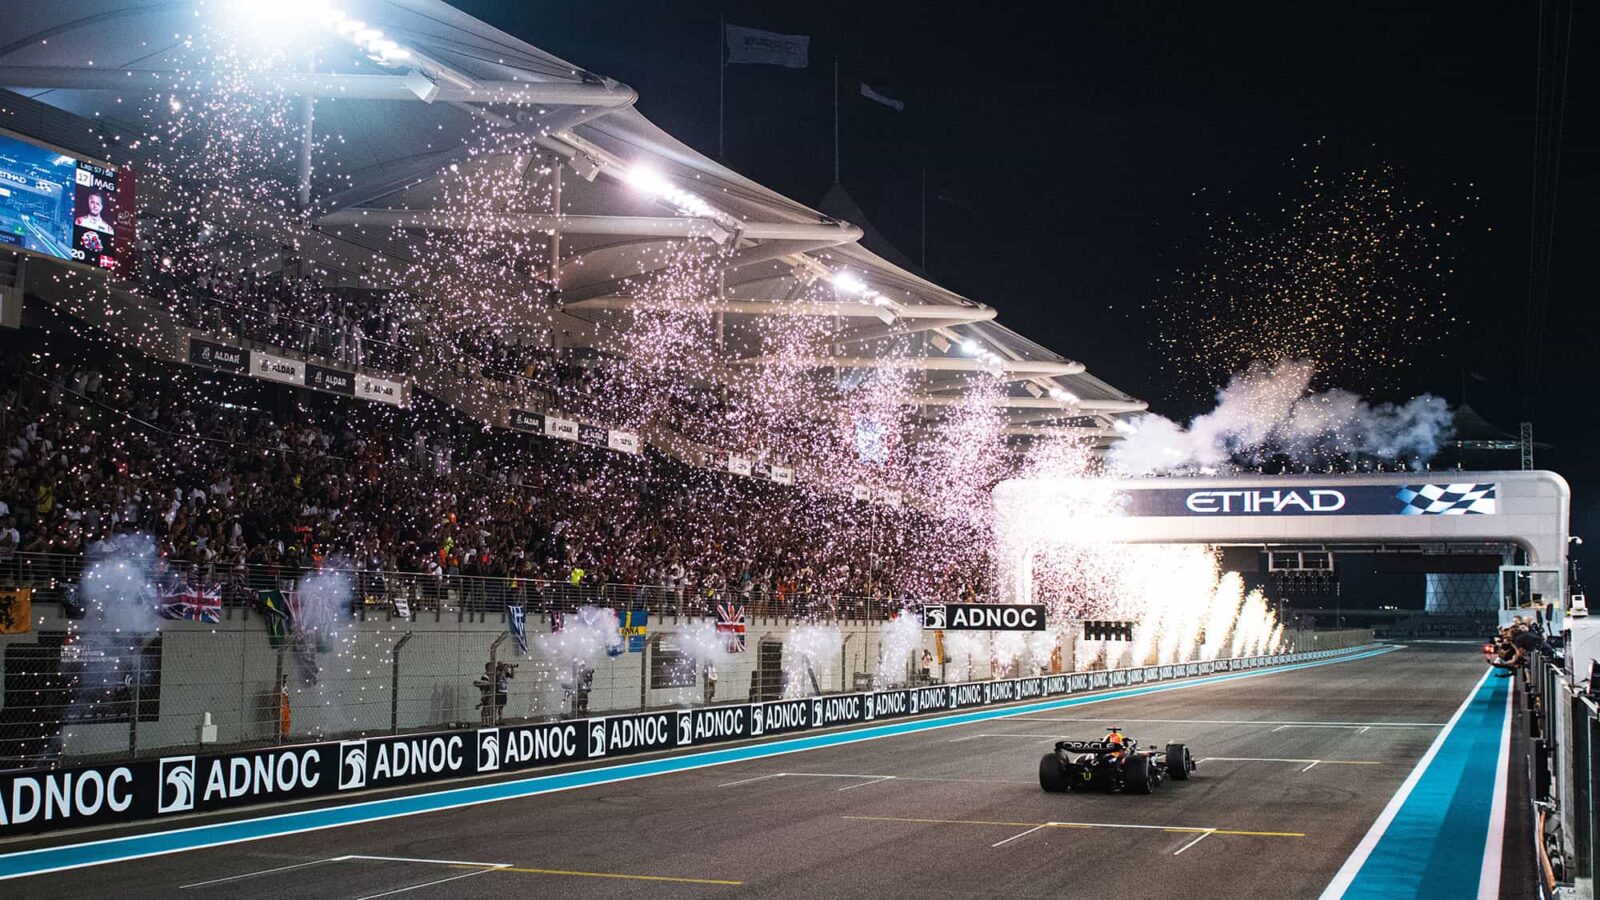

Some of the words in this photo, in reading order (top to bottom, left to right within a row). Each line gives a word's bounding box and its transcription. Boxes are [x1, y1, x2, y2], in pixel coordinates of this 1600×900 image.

[95, 178, 115, 191] MAG
[71, 248, 85, 260] 20
[214, 351, 240, 364] ALDAR
[325, 375, 347, 387] ALDAR
[1186, 489, 1346, 513] ETIHAD
[952, 607, 1037, 628] ADNOC
[919, 687, 946, 711] ADNOC
[957, 684, 982, 706] ADNOC
[991, 681, 1013, 701] ADNOC
[1022, 678, 1041, 697] ADNOC
[824, 696, 860, 722] ADNOC
[875, 691, 906, 716] ADNOC
[694, 708, 744, 739] ADNOC
[765, 702, 807, 730] ADNOC
[504, 725, 577, 764] ADNOC
[609, 715, 669, 750] ADNOC
[372, 735, 464, 780] ADNOC
[1063, 741, 1116, 750] ORACLE
[203, 749, 321, 801] ADNOC
